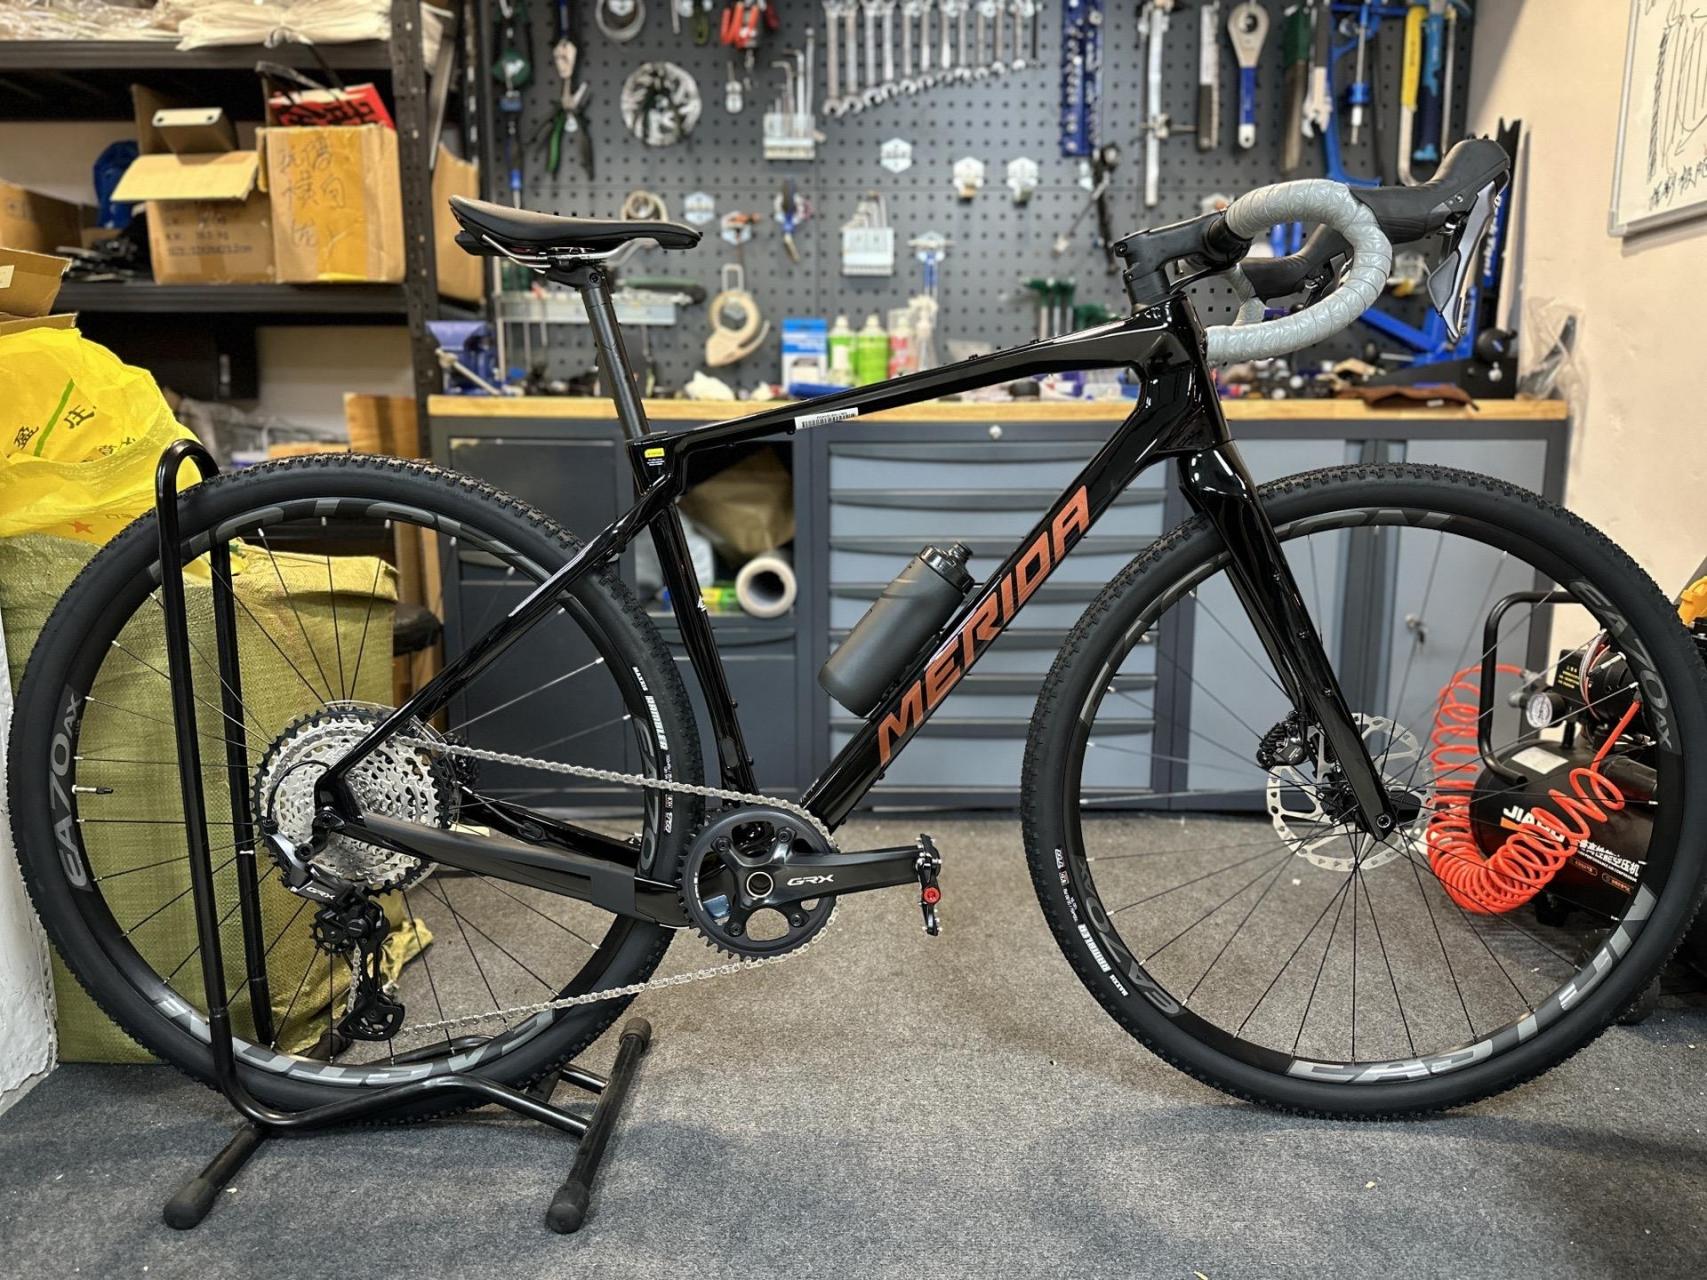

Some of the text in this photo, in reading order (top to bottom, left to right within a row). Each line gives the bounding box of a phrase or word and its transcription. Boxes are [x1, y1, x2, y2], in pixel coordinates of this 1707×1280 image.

[879, 485, 1089, 767] MERIDA
[632, 666, 648, 692] MAXXIS
[644, 696, 668, 751] RAMBLER
[306, 886, 336, 900] GRX
[787, 874, 834, 887] GRX
[1077, 923, 1112, 973] RAMBLER
